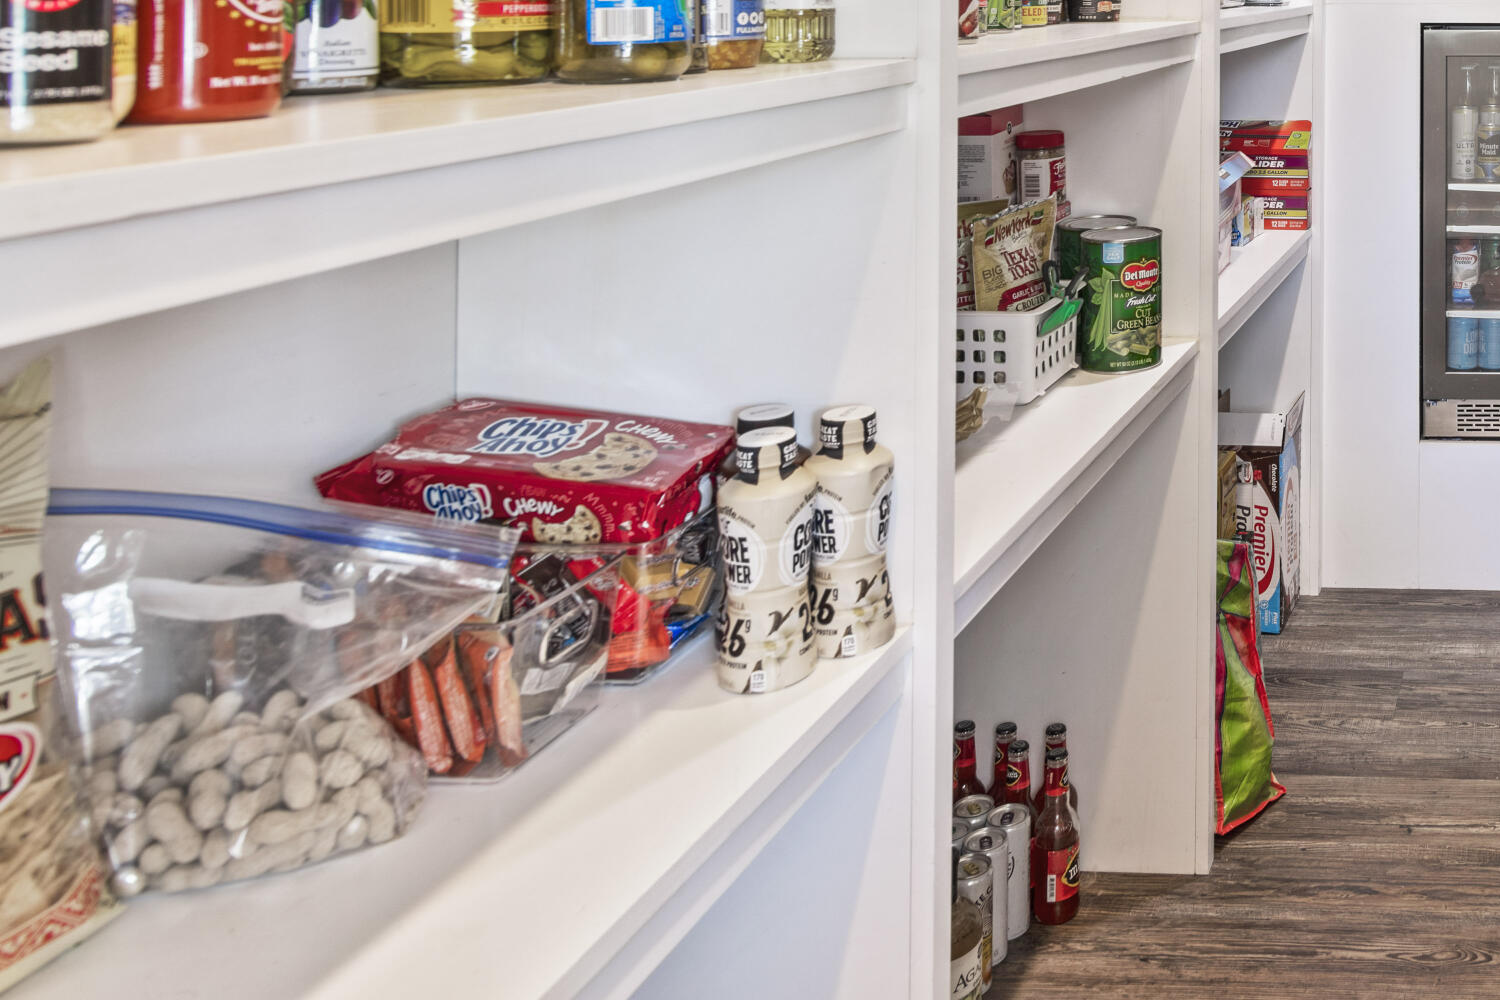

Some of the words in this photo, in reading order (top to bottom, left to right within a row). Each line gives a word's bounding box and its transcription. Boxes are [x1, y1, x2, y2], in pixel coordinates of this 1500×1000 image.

[1022, 6, 1043, 17] ELED
[1479, 142, 1499, 150] Minute
[1254, 160, 1285, 168] LIDER
[1263, 201, 1284, 209] DER
[993, 223, 1012, 244] New
[1011, 211, 1033, 236] York
[1000, 243, 1036, 267] TEXAS
[982, 265, 1003, 280] BIG
[1008, 259, 1040, 281] TOAST
[1124, 271, 1138, 281] Del
[1139, 267, 1159, 279] Monte
[1015, 295, 1046, 312] CROUTO
[1135, 308, 1152, 319] CUT
[1116, 318, 1144, 331] GREEN
[480, 416, 586, 442] Chips
[613, 419, 679, 448] CHEWY
[425, 484, 478, 510] Chips
[503, 496, 566, 517] CHEWY
[1253, 504, 1269, 575] Premier
